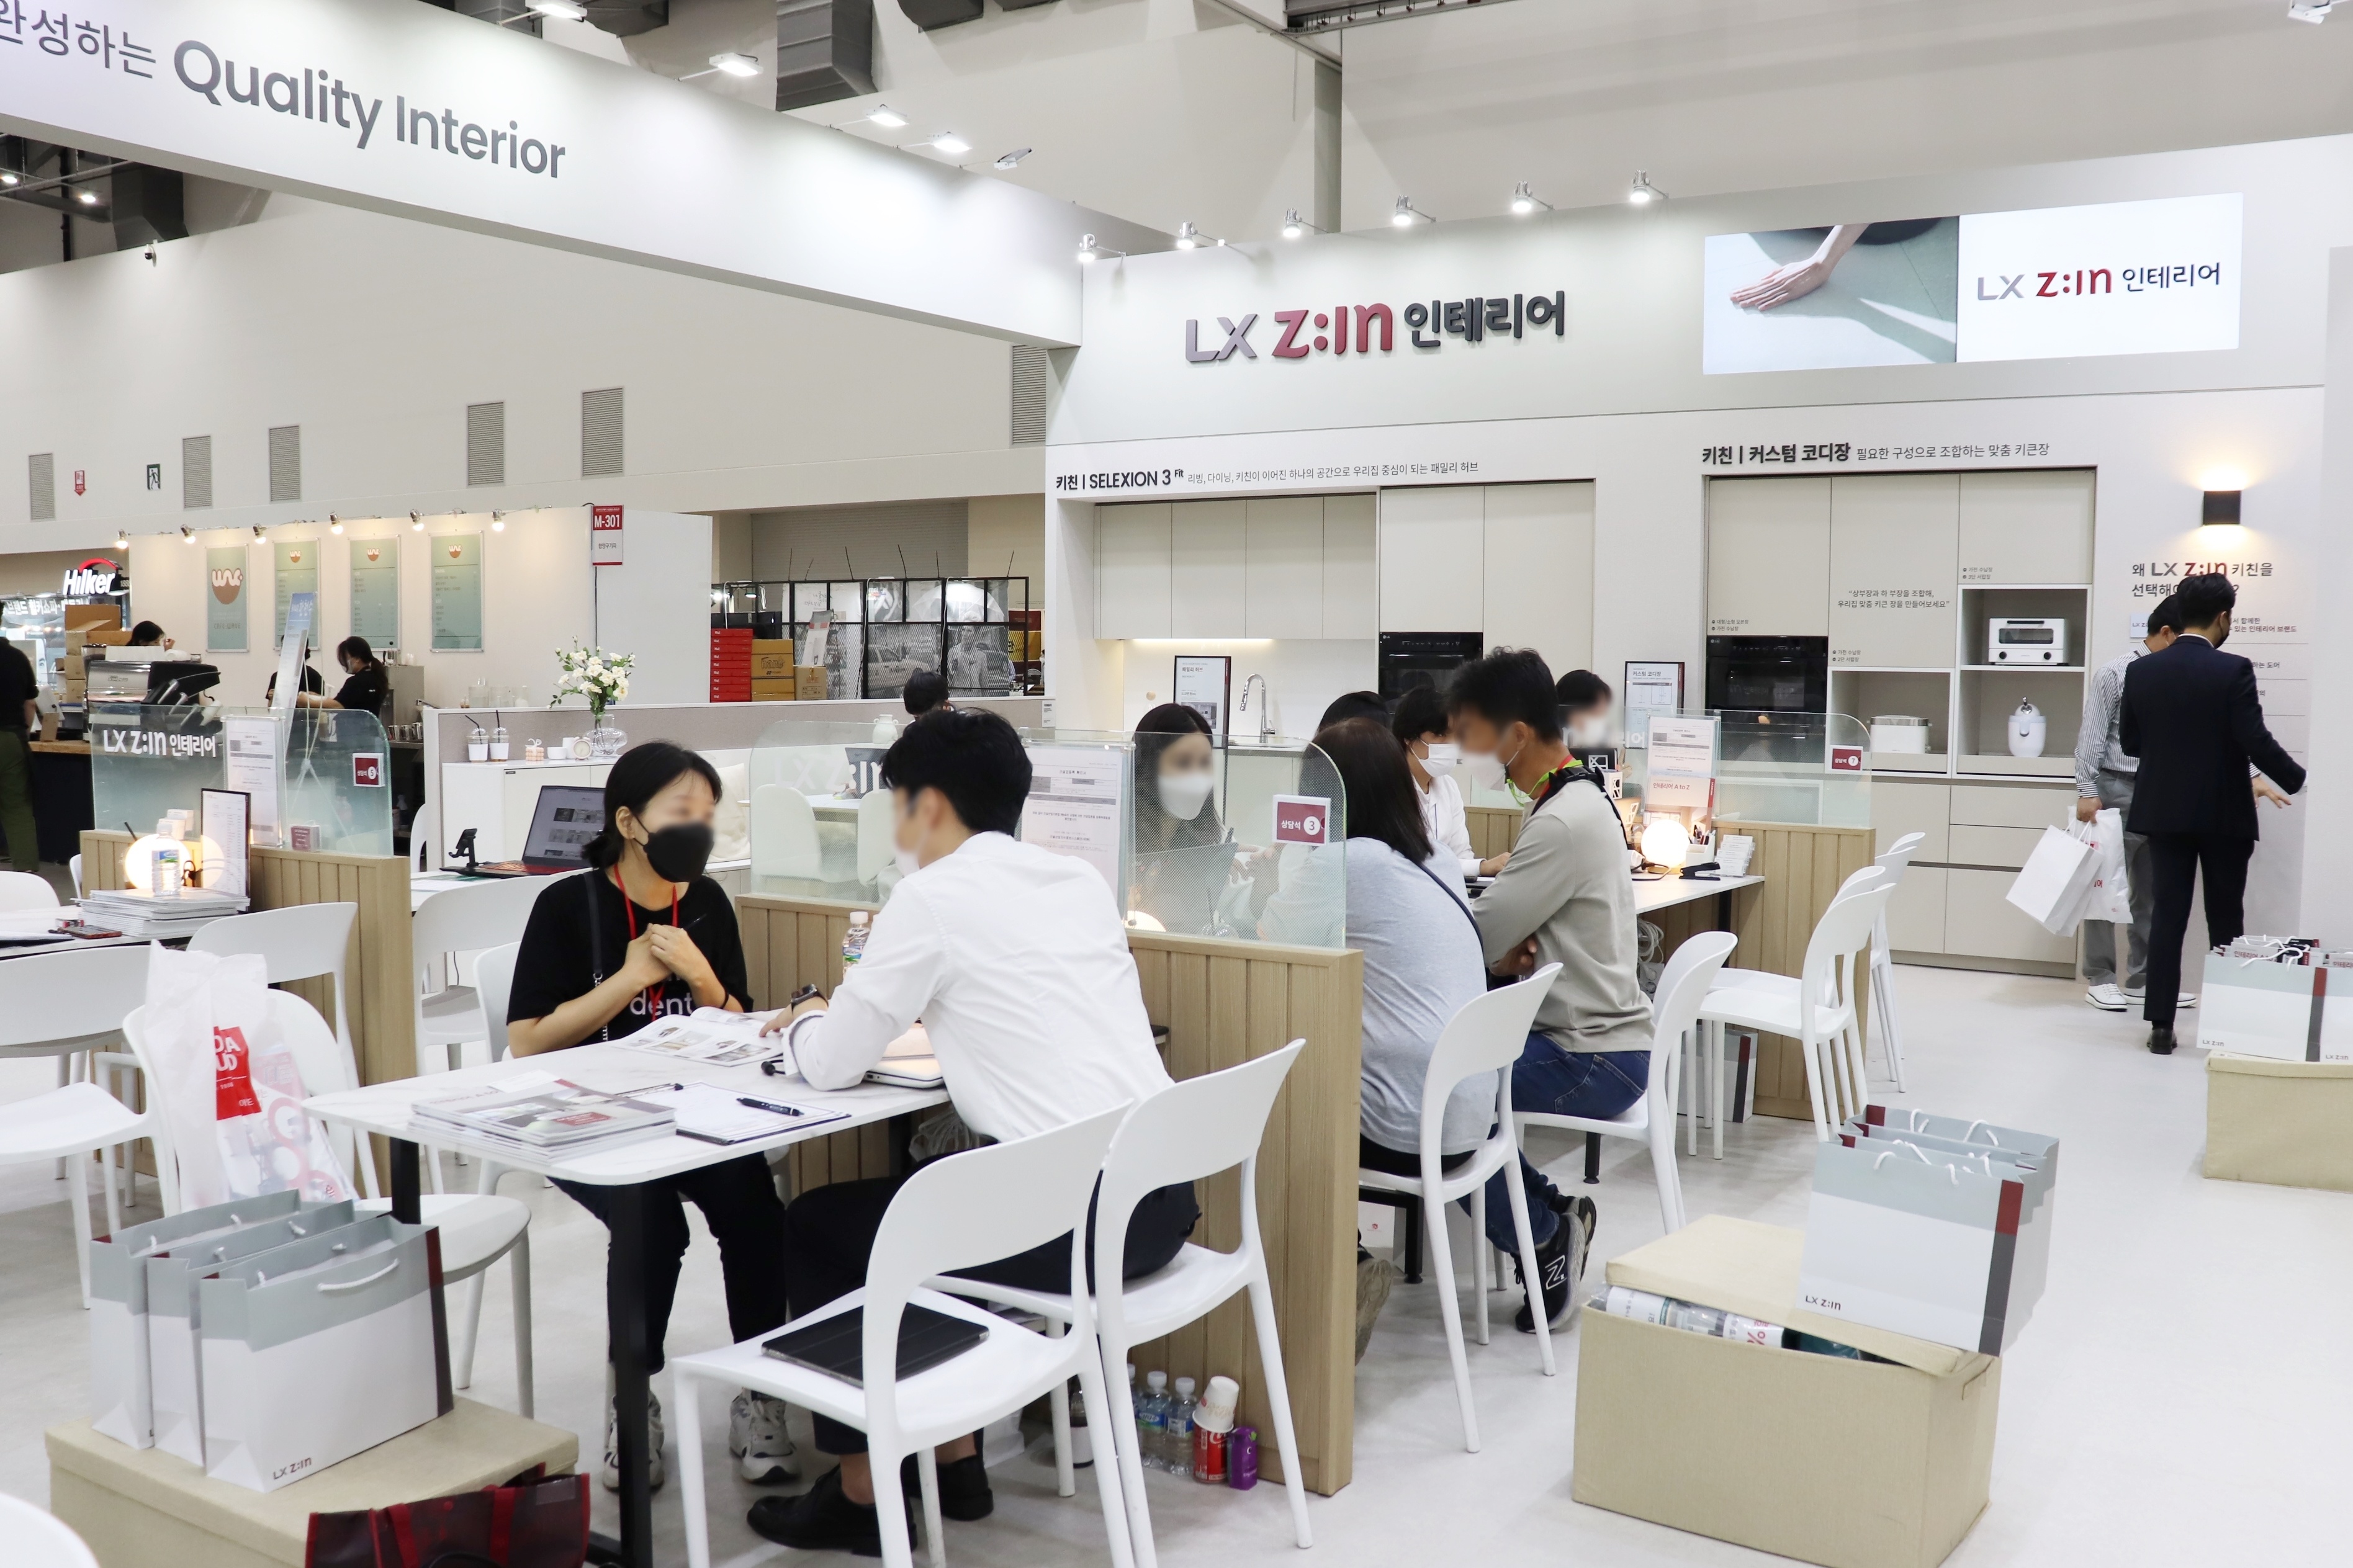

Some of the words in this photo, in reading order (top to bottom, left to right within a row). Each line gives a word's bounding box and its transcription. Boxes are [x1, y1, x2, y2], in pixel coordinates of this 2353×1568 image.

[174, 40, 382, 150] Quality
[397, 96, 565, 178] Interior
[1978, 275, 2024, 300] LX
[2123, 262, 2220, 292] 인테리어
[1185, 314, 1259, 364] LX
[1403, 290, 1565, 347] 인테리어
[1702, 446, 1732, 465] 키친
[1749, 444, 1796, 464] 커스텀
[1801, 442, 1851, 462] 코디장
[1856, 447, 1889, 460] 필요한
[1892, 446, 1937, 460] 구성으로
[1940, 445, 1985, 458] 조합하는
[1989, 444, 2011, 457] 맞춤
[2015, 443, 2049, 456] 키큰장
[1056, 474, 1078, 491] 키친
[1089, 470, 1158, 489] SELEXION
[1162, 468, 1171, 485] 3
[1175, 468, 1184, 478] Fit
[1187, 473, 1206, 485] 리빙,
[1208, 472, 1234, 484] 다이닝,
[1236, 470, 1259, 482] 키친이
[1262, 469, 1287, 481] 이어진
[1289, 468, 1314, 480] 하나의
[1316, 467, 1351, 478] 공간으로
[1353, 465, 1379, 477] 우리집
[1382, 464, 1407, 476] 중심이
[1410, 463, 1428, 474] 되는
[1431, 462, 1457, 473] 패밀리
[1460, 461, 1478, 472] 허브
[594, 514, 620, 527] M-301
[2132, 563, 2145, 576] 왜
[2151, 562, 2177, 576] LX
[2232, 563, 2273, 576] 키친을
[63, 568, 116, 595] Hilker
[1890, 589, 1910, 598] 부장을
[7, 601, 29, 616] 브랜드
[1837, 600, 1858, 608] 우리집
[1859, 600, 1873, 608] 맞춤
[1874, 600, 1888, 608] 키큰
[1890, 600, 1903, 608] 장을
[2277, 625, 2297, 633] 브랜드
[103, 730, 128, 753] LX
[169, 733, 217, 758] 인테리어
[369, 768, 374, 777] 5
[1280, 820, 1301, 830] 상담석
[1308, 820, 1315, 831] 3
[1805, 1294, 1819, 1306] LX
[272, 1468, 287, 1480] LX
